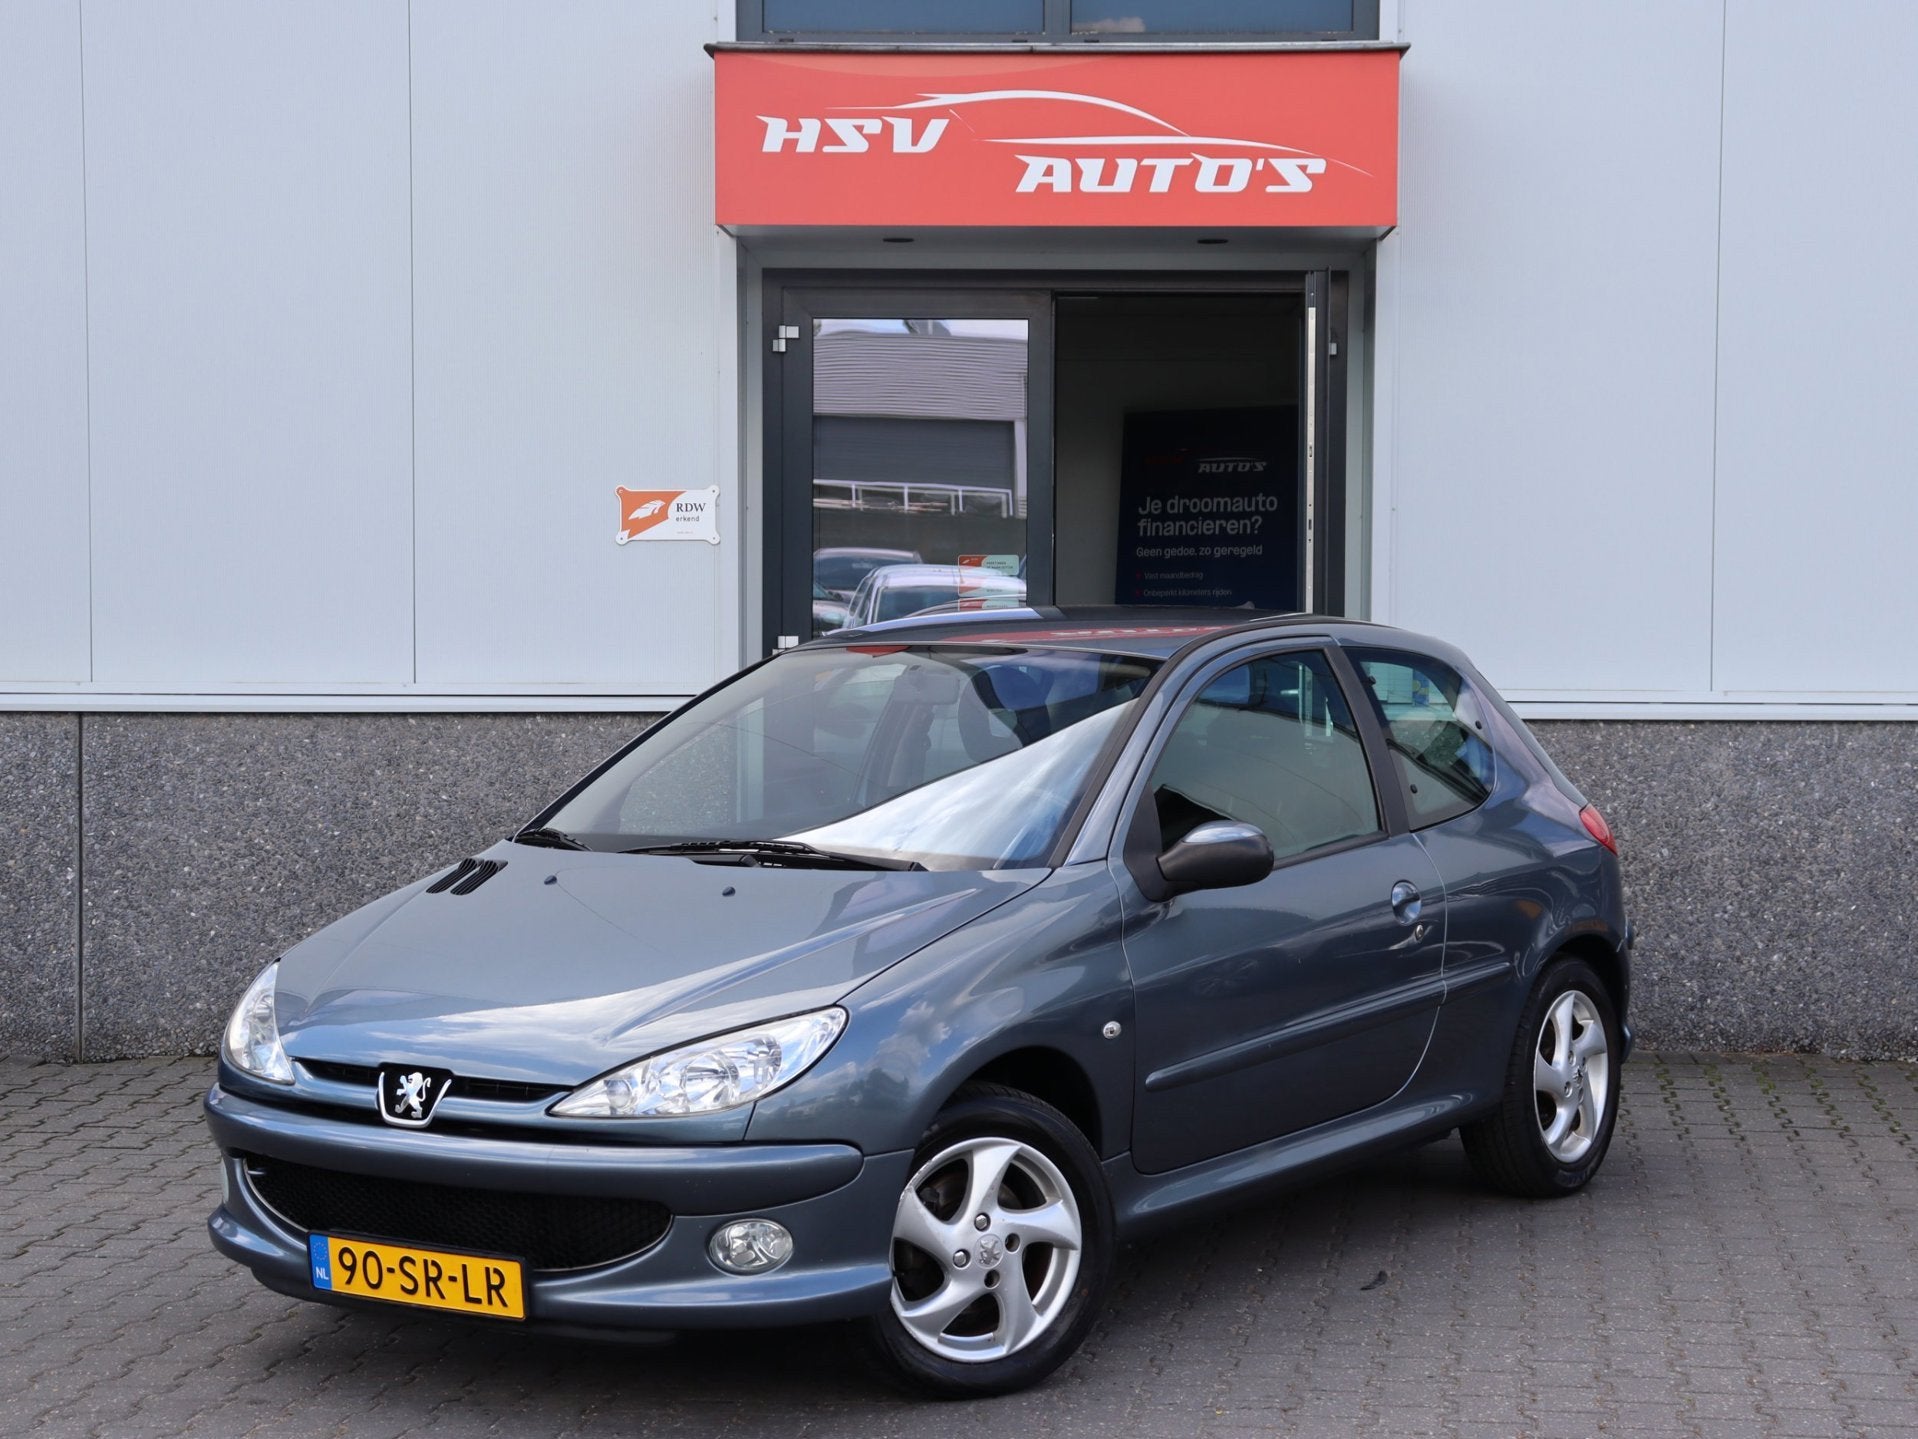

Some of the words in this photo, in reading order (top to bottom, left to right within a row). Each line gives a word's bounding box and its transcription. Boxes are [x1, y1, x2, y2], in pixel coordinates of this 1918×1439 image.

[756, 115, 949, 153] HSV
[1014, 152, 1326, 193] AUTO'S
[1198, 461, 1267, 473] AUTO'S
[676, 503, 707, 512] RDW
[1138, 496, 1162, 515] Je
[1166, 493, 1278, 514] droomauto
[1137, 516, 1263, 536] financieren?
[1136, 547, 1162, 557] Geen
[1199, 547, 1211, 556] zo
[1214, 544, 1263, 558] geregeld
[315, 1266, 329, 1281] NL
[338, 1246, 509, 1308] 90-SR-LR
